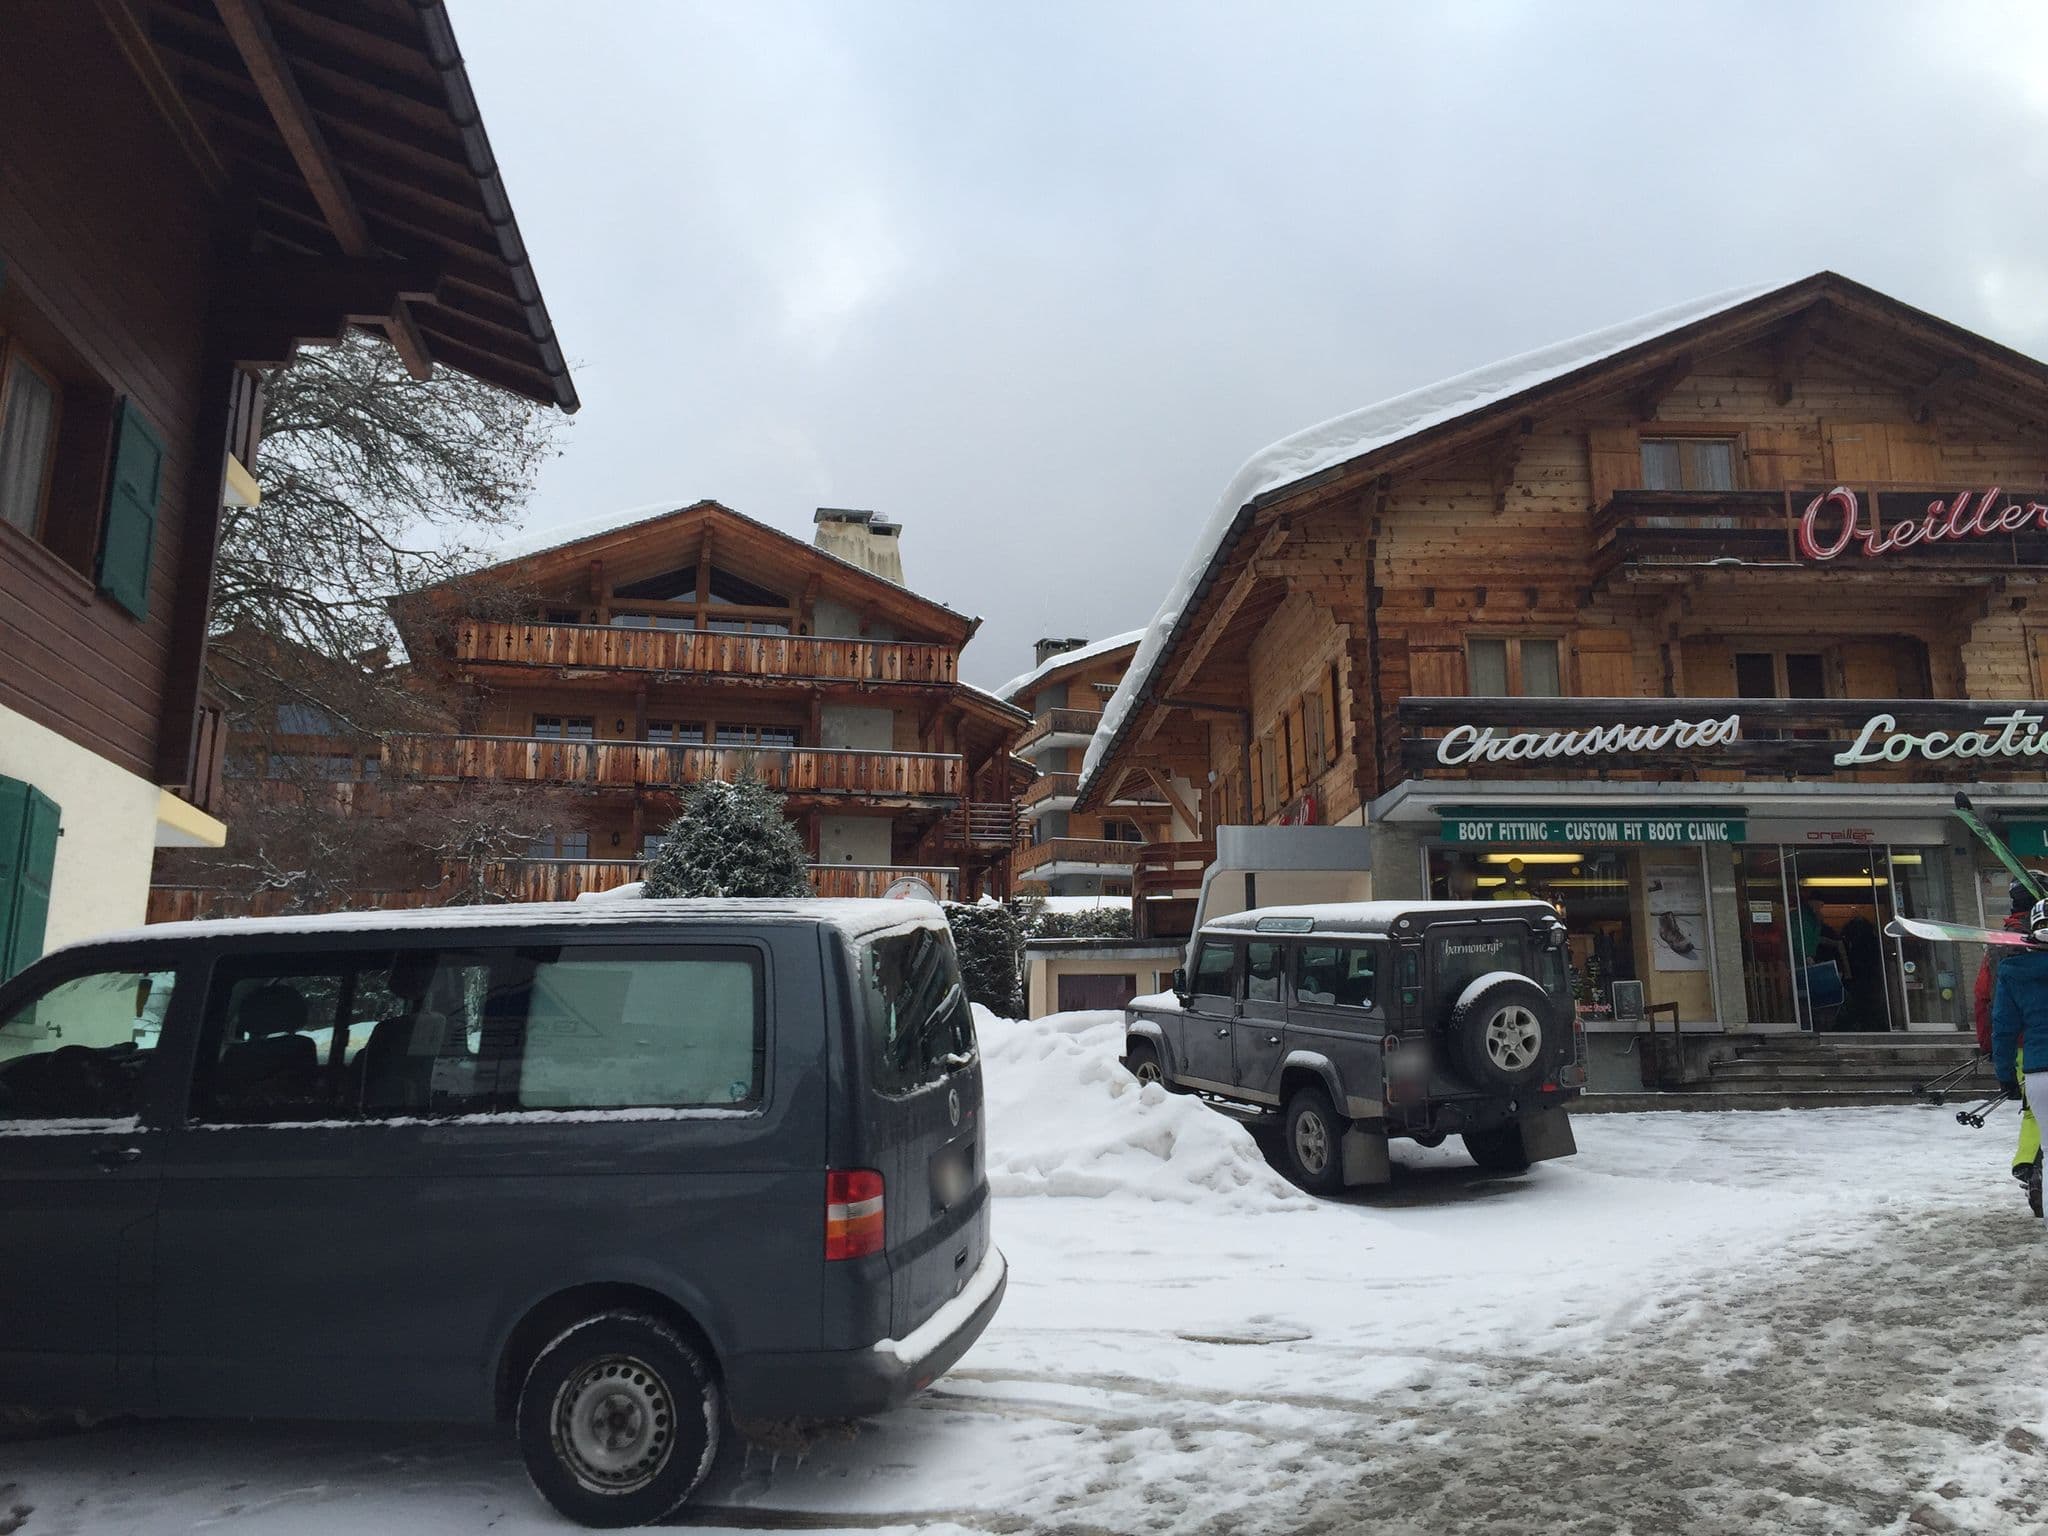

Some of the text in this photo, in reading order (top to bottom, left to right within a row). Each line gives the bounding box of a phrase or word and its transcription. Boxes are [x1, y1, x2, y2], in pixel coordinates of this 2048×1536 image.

[1437, 714, 1740, 764] Chaussures
[1459, 822, 1493, 840] BOOT
[1499, 822, 1548, 840] FITTING
[1565, 822, 1618, 841] CUSTOM
[1624, 822, 1643, 840] FIT
[1648, 822, 1682, 840] BOOT
[1688, 822, 1729, 841] CLINIC
